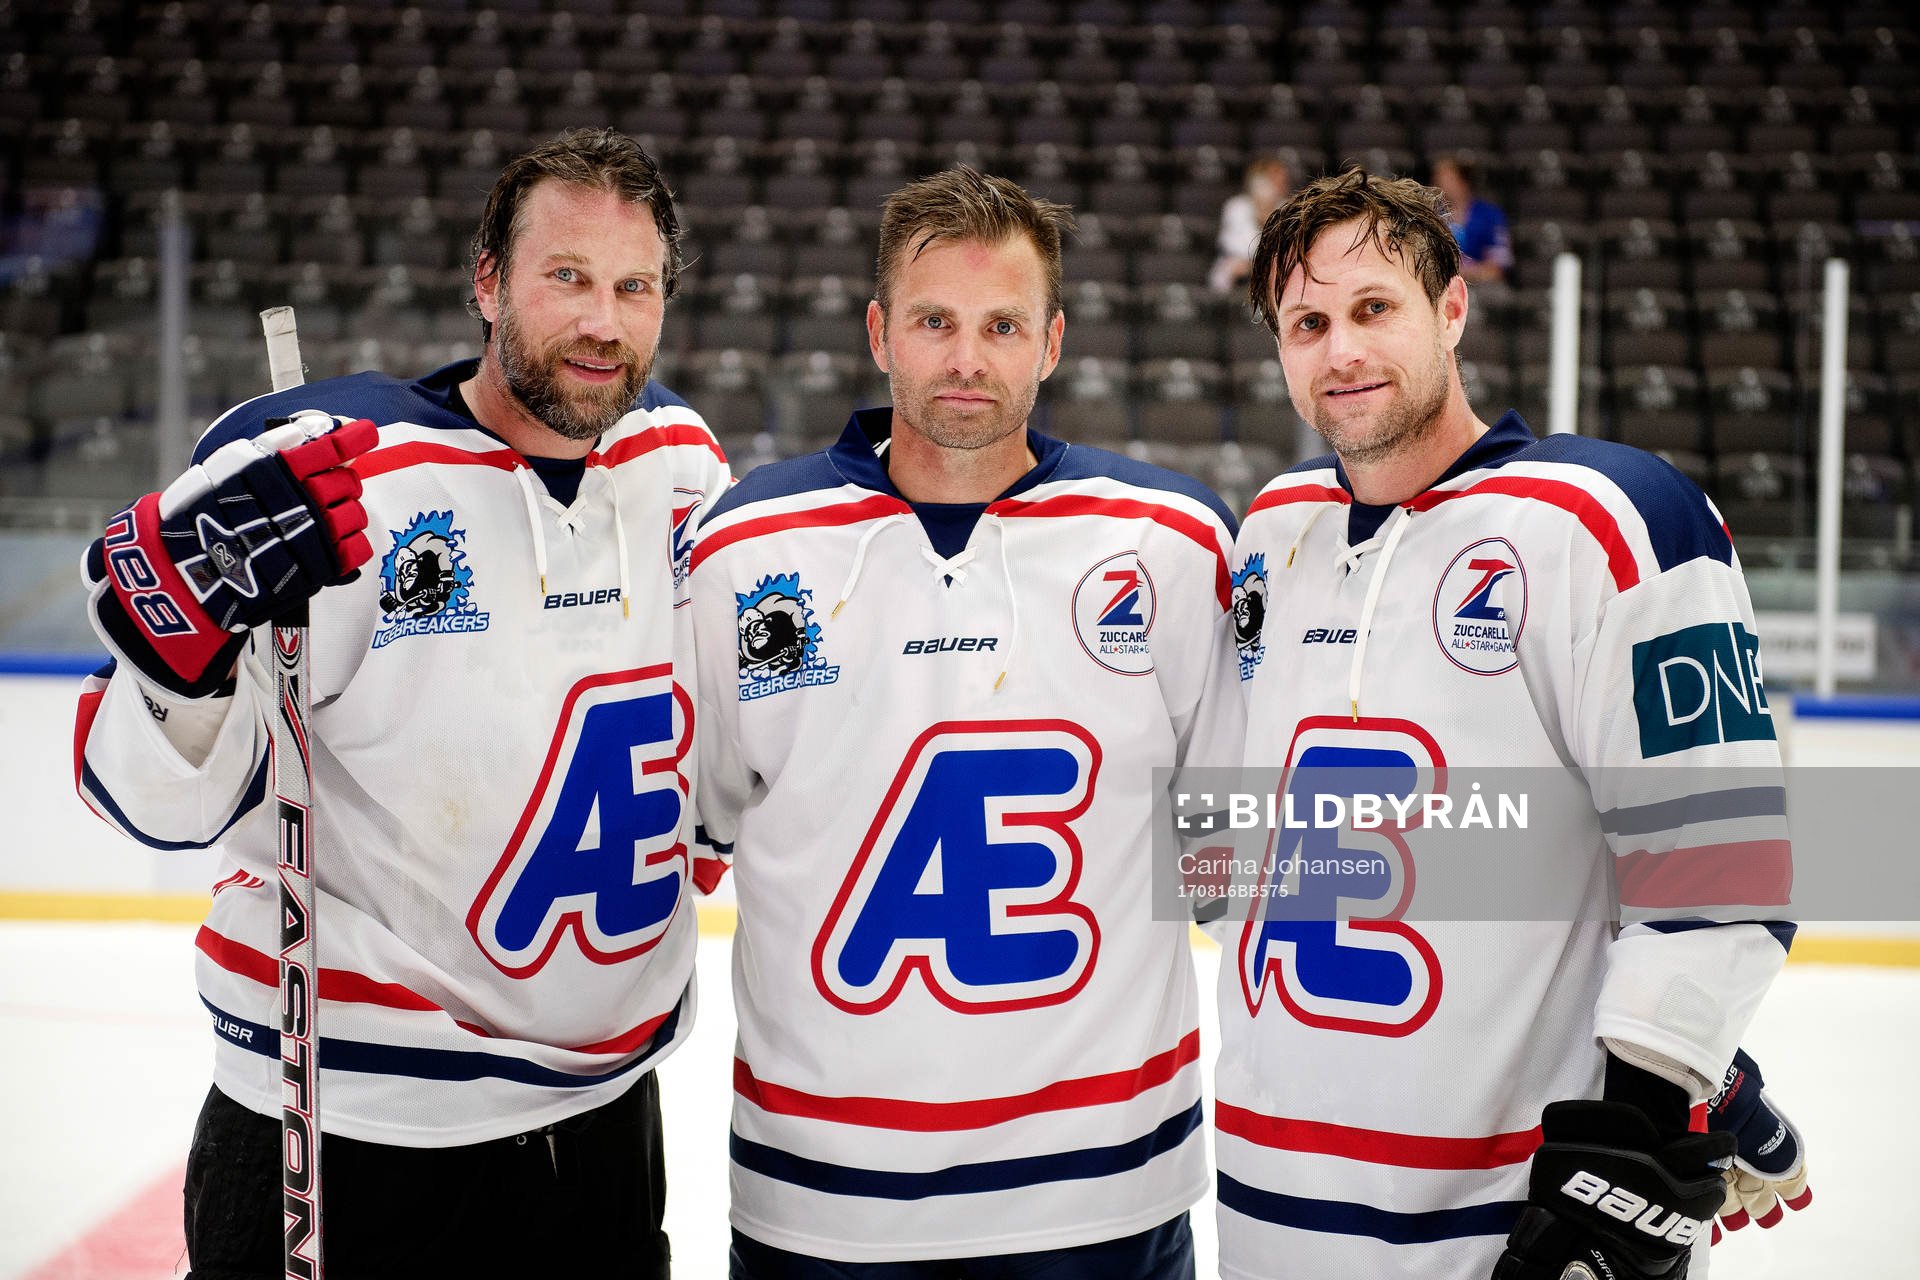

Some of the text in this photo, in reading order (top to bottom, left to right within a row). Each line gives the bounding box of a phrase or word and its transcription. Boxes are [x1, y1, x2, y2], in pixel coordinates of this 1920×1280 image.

[372, 612, 490, 649] ICEBREAKERS
[816, 724, 1098, 1010] Æ
[277, 798, 316, 1280] EASTON
